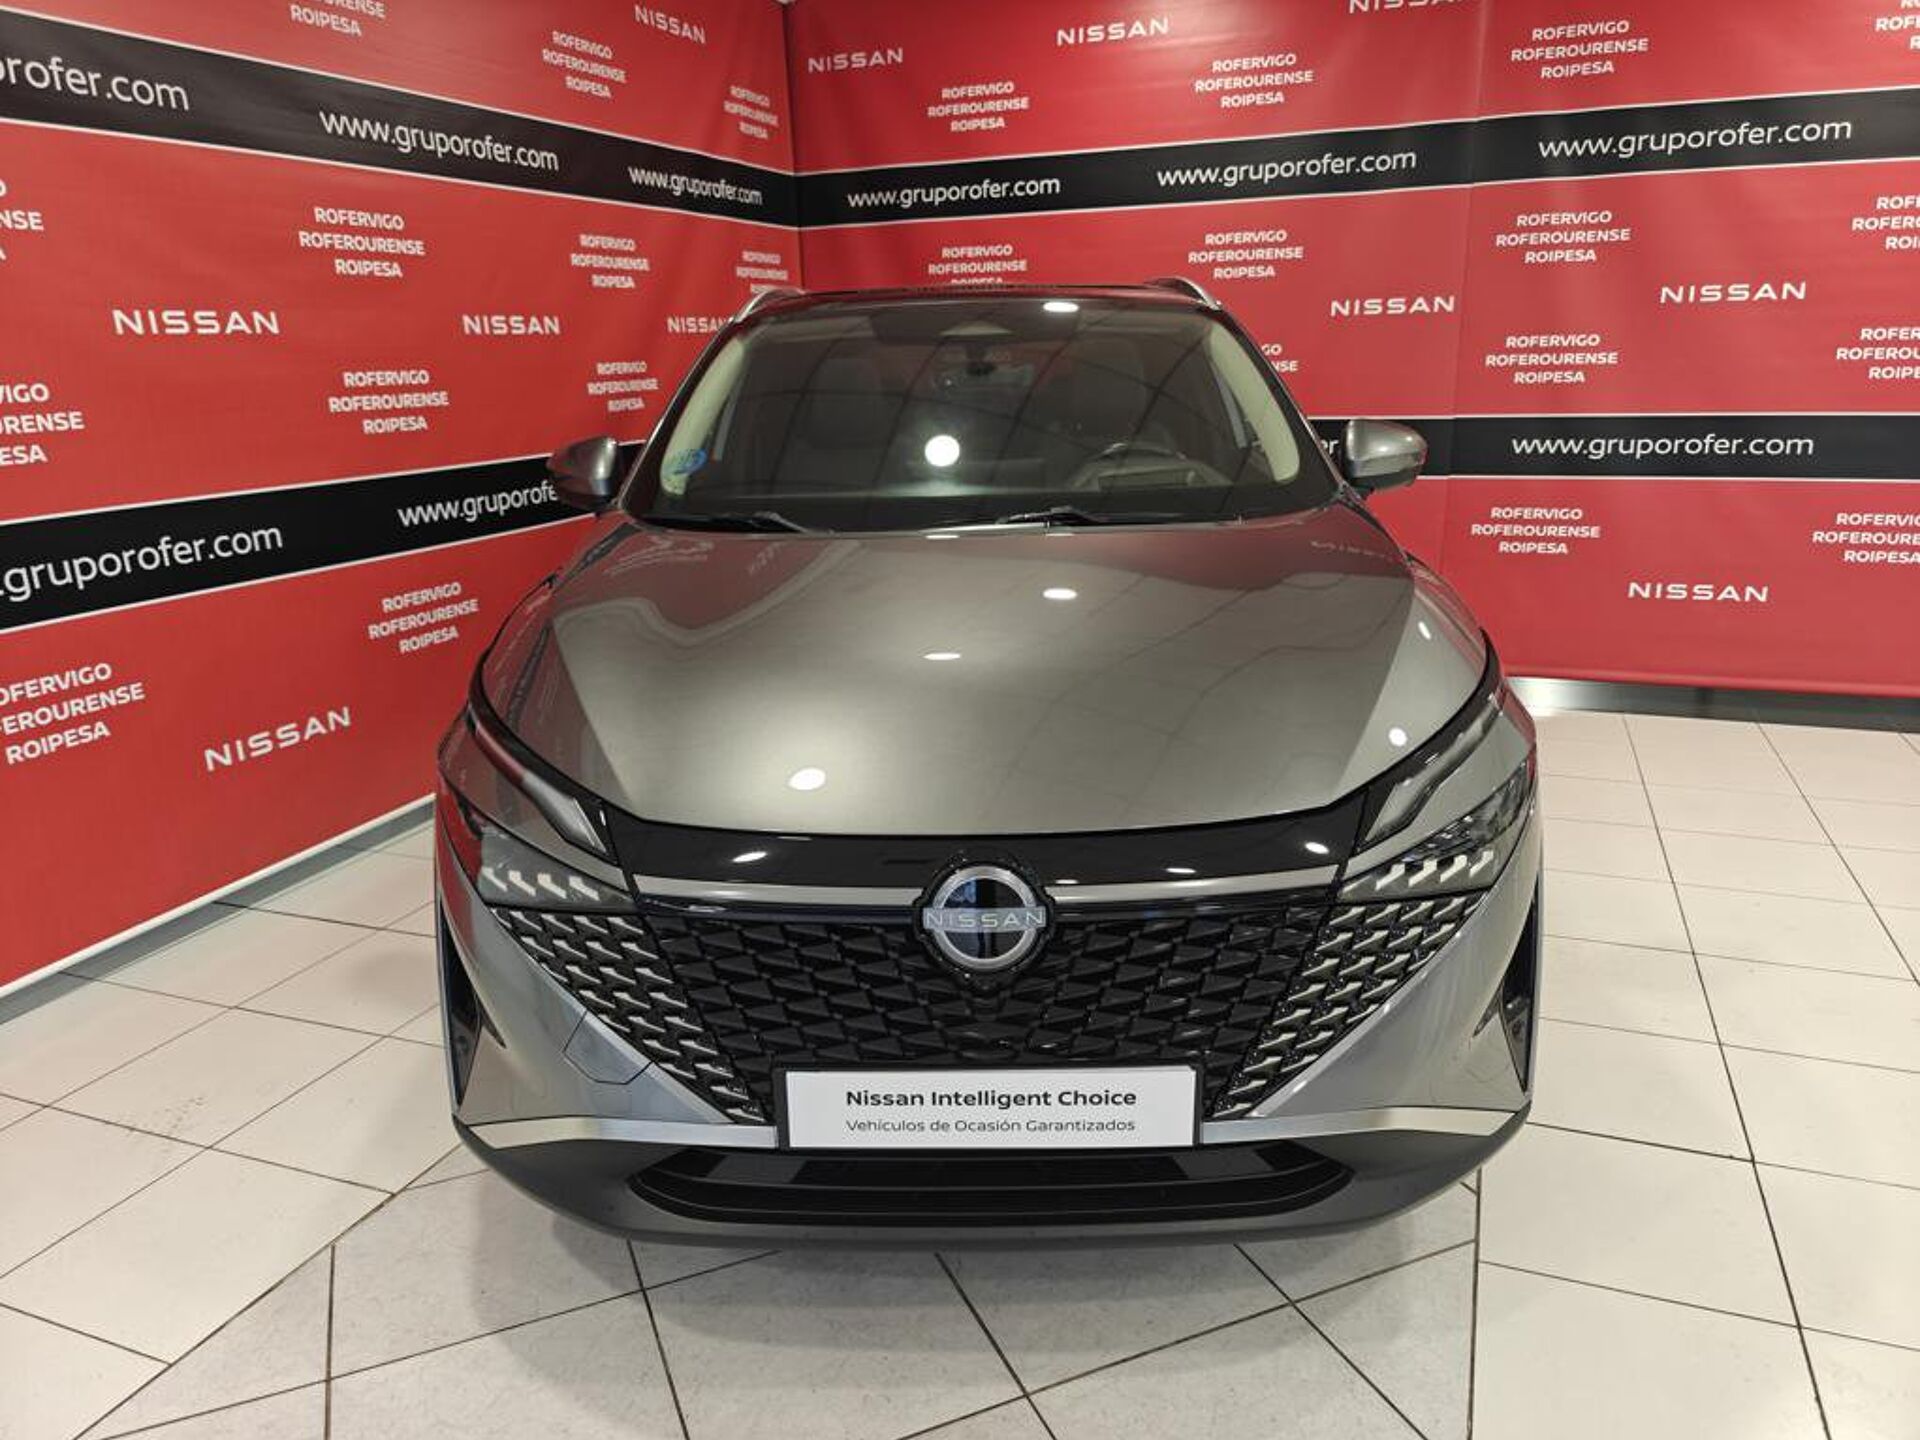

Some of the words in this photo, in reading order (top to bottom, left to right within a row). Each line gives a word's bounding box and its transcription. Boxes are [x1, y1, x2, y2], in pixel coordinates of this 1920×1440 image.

[290, 4, 361, 36] ROIPESA
[635, 5, 705, 43] NISSAN
[1057, 18, 1167, 46] NISSAN
[1532, 20, 1629, 40] ROFERVIGO
[1511, 38, 1648, 61] ROFEROURENSE
[808, 48, 903, 72] NISSAN
[1213, 53, 1296, 72] ROFERVIGO
[1541, 61, 1614, 78] ROIPESA
[0, 58, 189, 110] rofer.com
[942, 81, 1014, 98] ROFERVIGO
[1194, 70, 1313, 92] ROFEROURENSE
[928, 97, 1029, 117] ROFEROURENSE
[1221, 92, 1284, 108] ROIPESA
[951, 117, 1005, 131] ROIPESA
[320, 112, 558, 170] www.gruporofer.com
[1539, 122, 1851, 158] www.gruporofer.com
[1157, 152, 1416, 186] www.gruporofer.com
[628, 166, 762, 206] www.gruporofer.com
[848, 178, 1060, 208] www.gruporofer.com
[314, 207, 404, 230] ROFERVIGO
[1517, 210, 1612, 226] ROFERVIGO
[299, 231, 425, 255] ROFEROURENSE
[1205, 230, 1287, 245] ROFERVIGO
[1496, 229, 1630, 246] ROFEROURENSE
[942, 244, 1013, 258] ROFERVIGO
[1188, 247, 1303, 263] ROFEROURENSE
[1525, 250, 1596, 263] ROIPESA
[335, 259, 403, 277] ROIPESA
[928, 260, 1026, 274] ROFEROURENSE
[1214, 266, 1275, 279] ROIPESA
[1661, 282, 1805, 303] NISSAN
[1331, 296, 1454, 316] NISSAN
[113, 310, 279, 334] NISSAN
[463, 315, 560, 334] NISSAN
[1506, 334, 1600, 347] ROFERVIGO
[1486, 352, 1618, 367] ROFEROURENSE
[343, 370, 429, 386] ROFERVIGO
[1514, 371, 1585, 384] ROIPESA
[328, 391, 449, 412] ROFEROURENSE
[363, 416, 428, 434] ROIPESA
[1512, 434, 1813, 459] www.gruporofer.com
[1491, 507, 1583, 519] ROFERVIGO
[1471, 524, 1600, 538] ROFEROURENSE
[1499, 541, 1568, 554] ROIPESA
[1844, 550, 1920, 564] ROIPESA
[382, 582, 461, 612] ROFERVIGO
[1629, 583, 1768, 602] NISSAN
[368, 599, 478, 639] ROFEROURENSE
[399, 626, 458, 653] ROIPESA
[6, 722, 110, 764] ROIPESA
[205, 707, 350, 771] NISSAN
[926, 911, 1043, 928] NISSAN
[846, 1090, 924, 1106] Nissan
[931, 1090, 1051, 1110] Intelligent
[1057, 1090, 1137, 1106] Choice
[846, 1119, 925, 1132] Vehículos
[930, 1119, 950, 1132] de
[954, 1119, 1021, 1132] Ocasión
[1026, 1119, 1136, 1132] Garantizados
